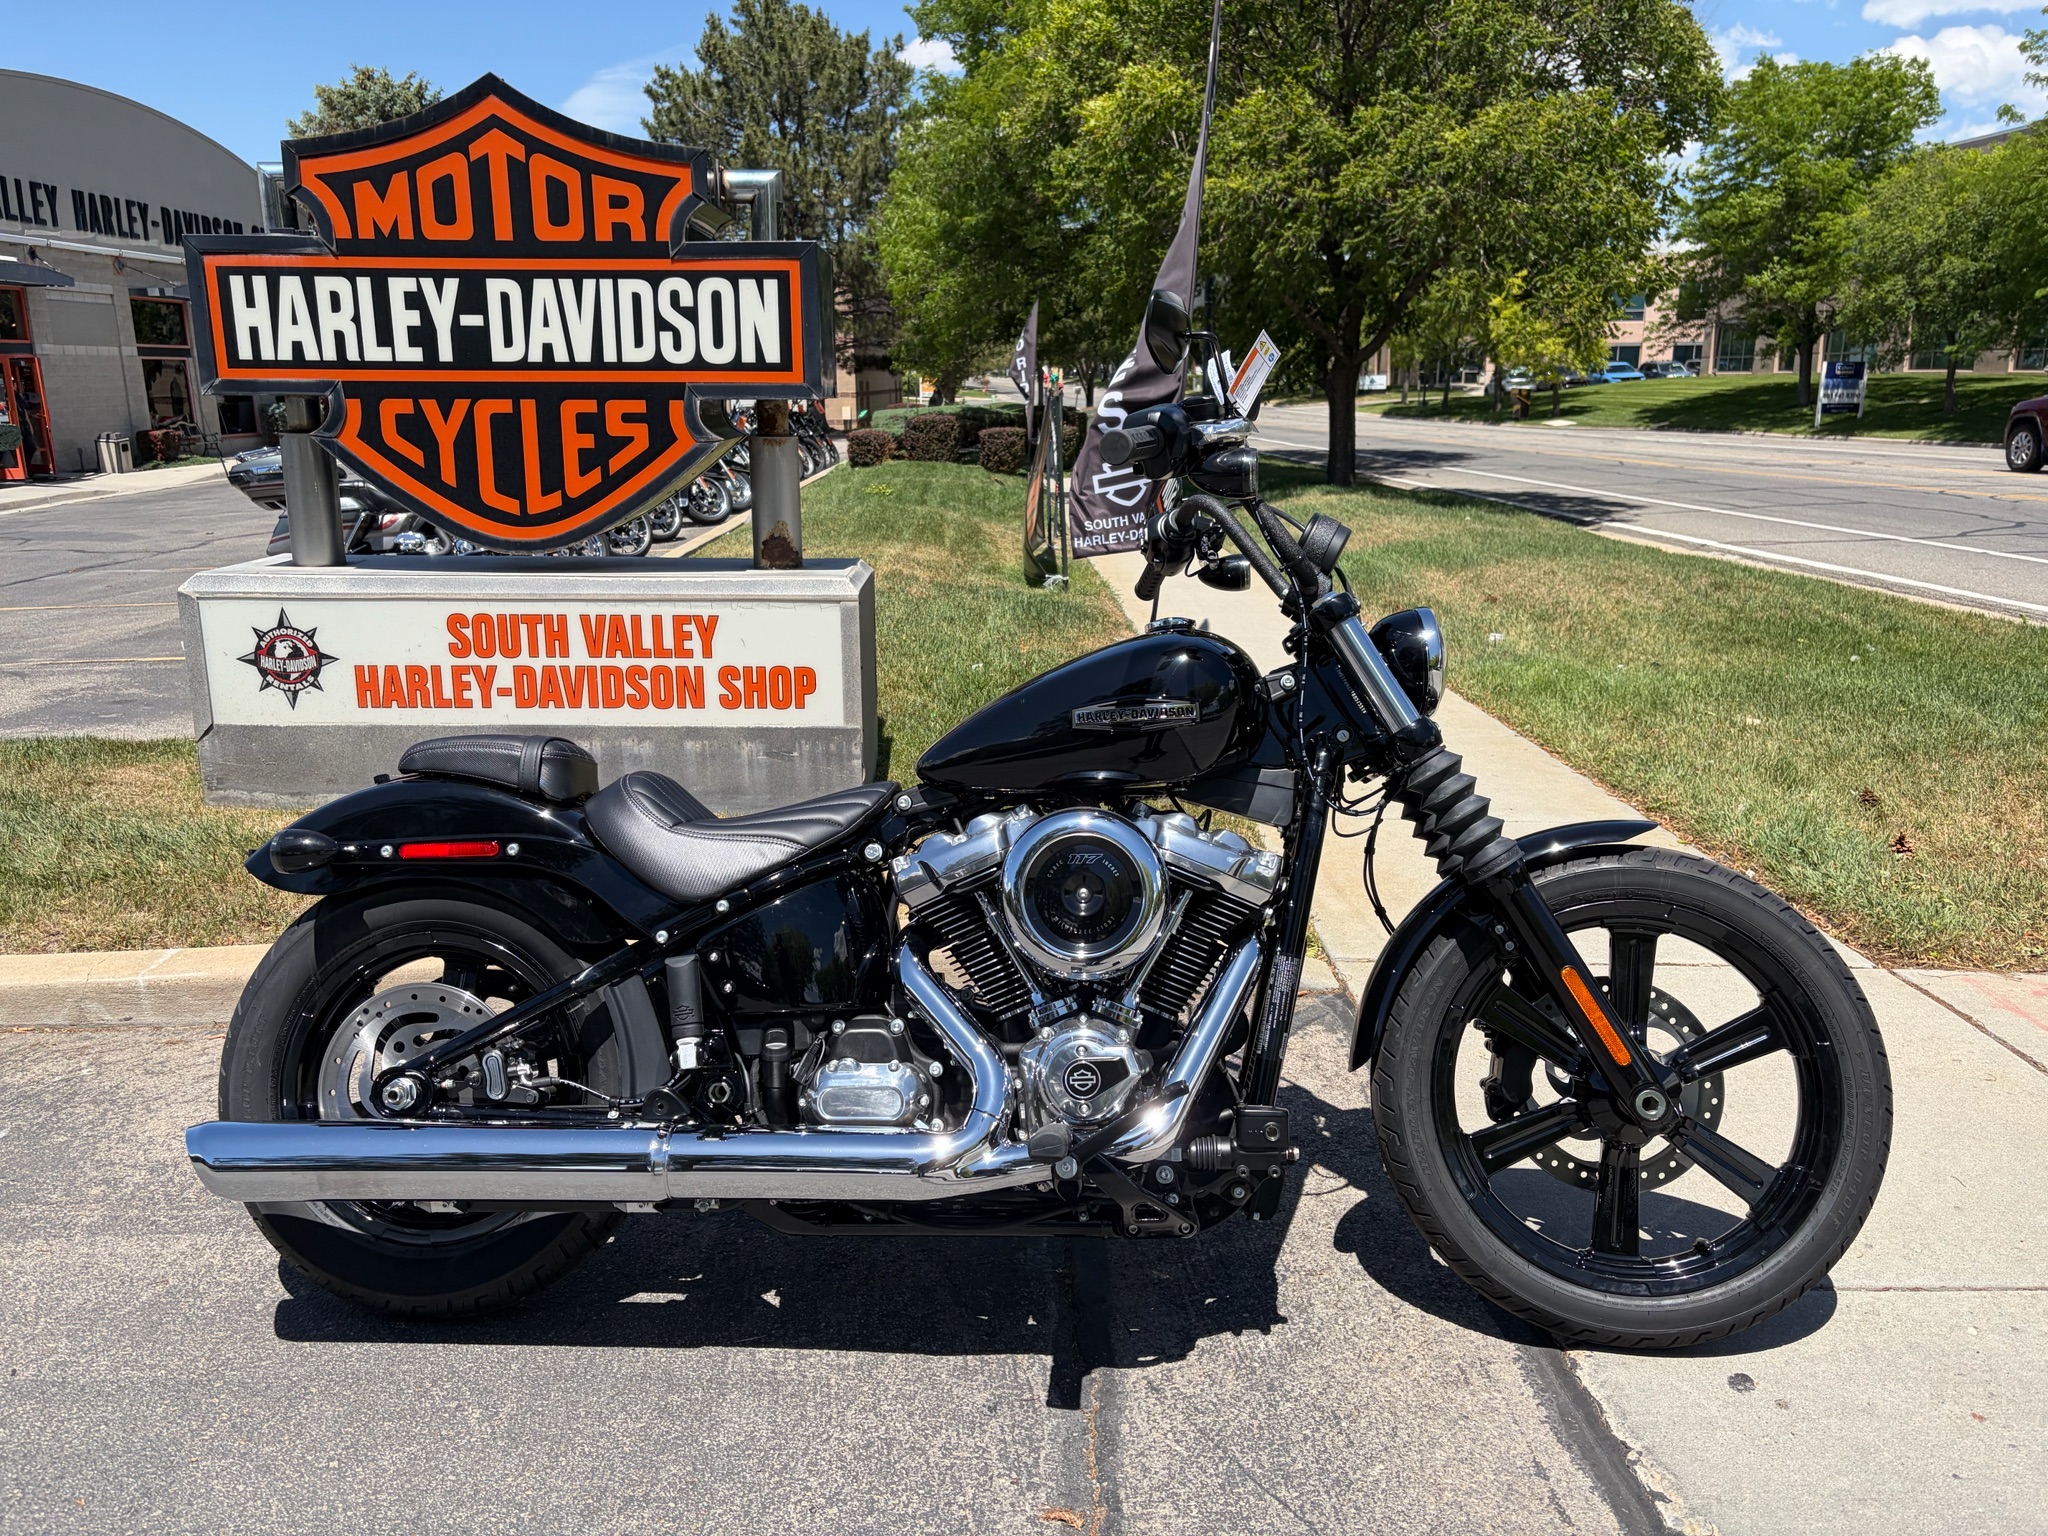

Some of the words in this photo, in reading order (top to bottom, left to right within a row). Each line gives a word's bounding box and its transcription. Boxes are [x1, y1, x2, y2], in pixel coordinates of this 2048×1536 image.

[0, 175, 59, 228] LLEY
[353, 128, 646, 242] MOTOR
[229, 275, 781, 364] HARLEY-DAVIDSON
[379, 398, 649, 515] CYCLES
[1084, 514, 1129, 532] SOUTH
[260, 628, 314, 649] AUTHORIZED
[447, 613, 569, 658] SOUTH
[580, 613, 719, 659] VALLEY
[260, 654, 317, 673] HARLEY-DAVIDSON
[265, 674, 315, 691] RENTALS
[355, 664, 706, 710] HARLEY-DAVIDSON
[718, 664, 817, 710] SHOP
[1076, 704, 1196, 723] HARLEY-DAVIDSON
[1067, 853, 1104, 865] 117
